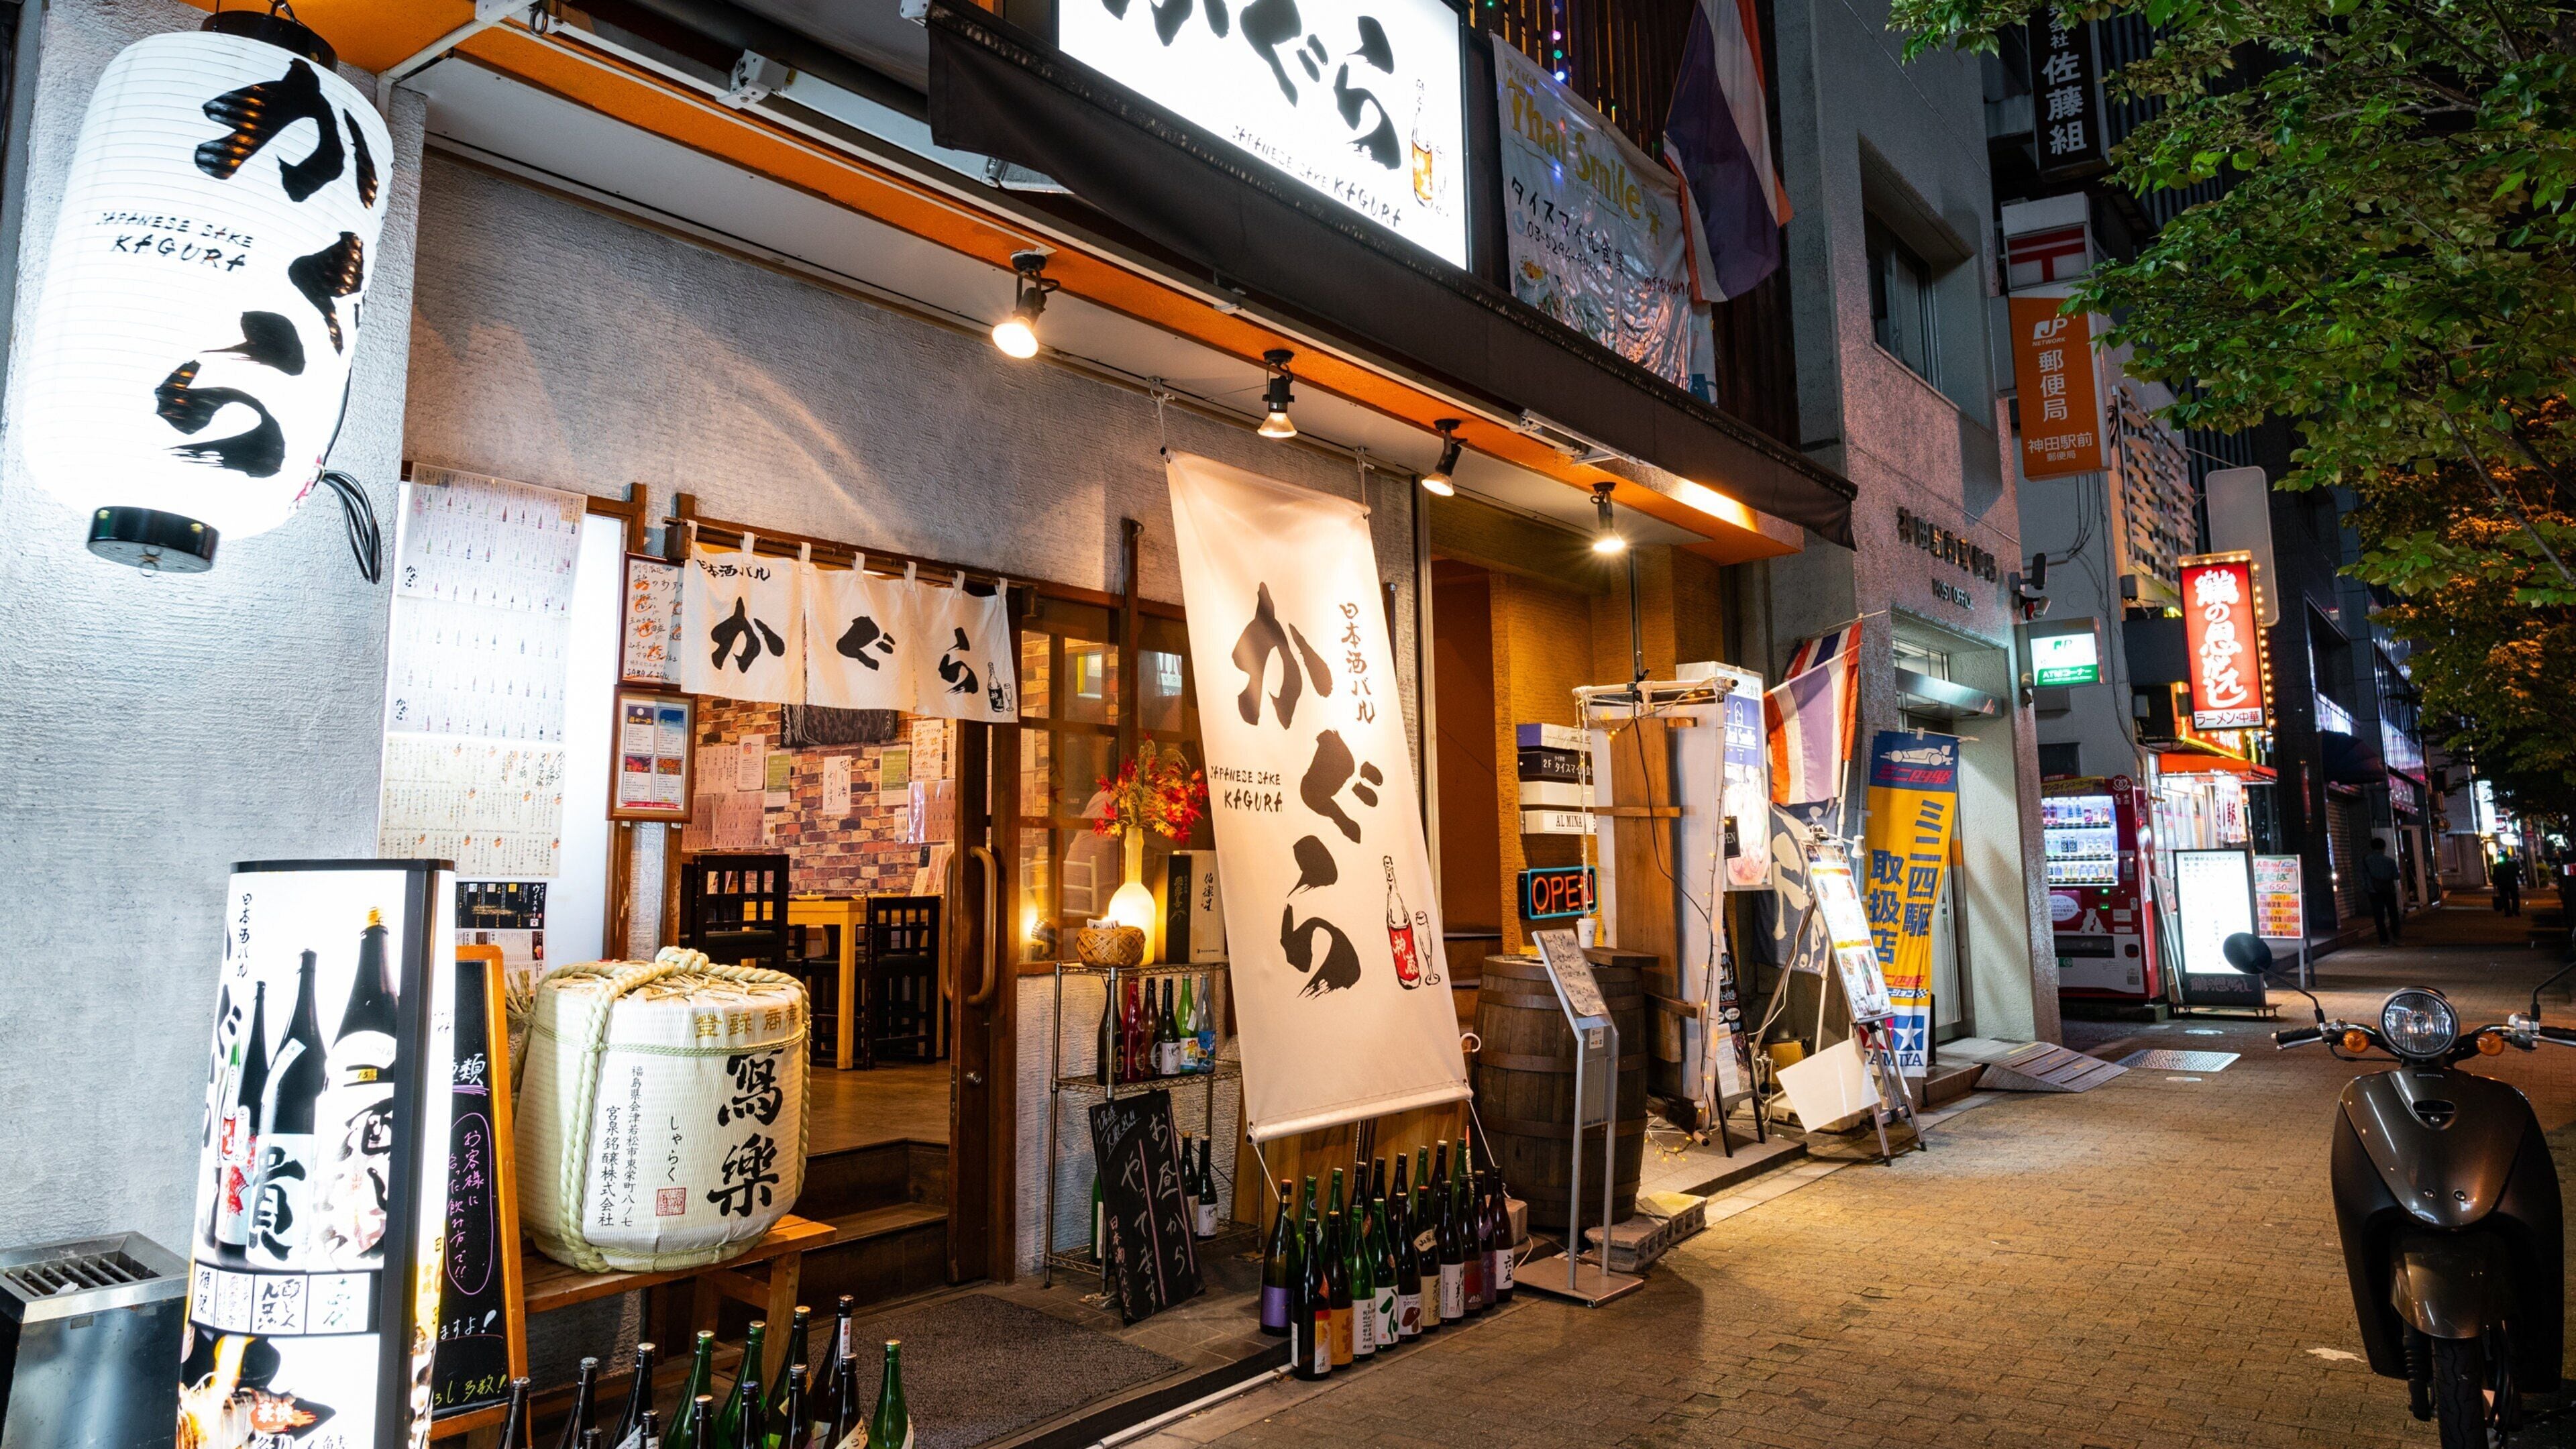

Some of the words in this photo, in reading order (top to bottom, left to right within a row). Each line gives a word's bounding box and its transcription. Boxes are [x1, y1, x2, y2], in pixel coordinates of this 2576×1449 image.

[2041, 51, 2088, 156] 佐藤組
[1507, 78, 1567, 168] Thai
[1575, 131, 1642, 220] Smile
[96, 211, 190, 233] JAPANESE
[200, 223, 254, 249] SAKE
[1334, 176, 1401, 227] KAGURA
[1511, 176, 1625, 274] タイスマイル食堂
[110, 233, 246, 272] KAGURA
[2031, 336, 2067, 347] NETWORK
[2039, 348, 2068, 423] 郵便局
[2027, 431, 2093, 454] 神田駅前
[2046, 449, 2077, 462] 郵便局
[696, 559, 771, 582] 日本酒バル
[710, 596, 979, 695] かぐら
[1339, 602, 1376, 724] 日本酒バル
[2194, 569, 2248, 709] 鶴の恩がえし
[2196, 710, 2261, 726] ラーメン・中華
[1210, 765, 1253, 784] JAPANESE
[1258, 771, 1281, 786] SAKE
[1224, 788, 1283, 813] KAGURA
[1231, 581, 1383, 1000] かぐら
[1556, 814, 1564, 828] AL
[1565, 815, 1582, 828] MINA
[1532, 875, 1594, 910] OPEN
[1901, 799, 1945, 938] ミニ四駆
[1868, 849, 1904, 965] 取扱店
[1882, 974, 1925, 987] ニ四駆
[462, 1130, 484, 1205] お客様に
[667, 1116, 682, 1182] しゃらく
[254, 1142, 307, 1262] 貴
[1149, 1113, 1186, 1277] お昼から
[1128, 1150, 1158, 1315] やってます
